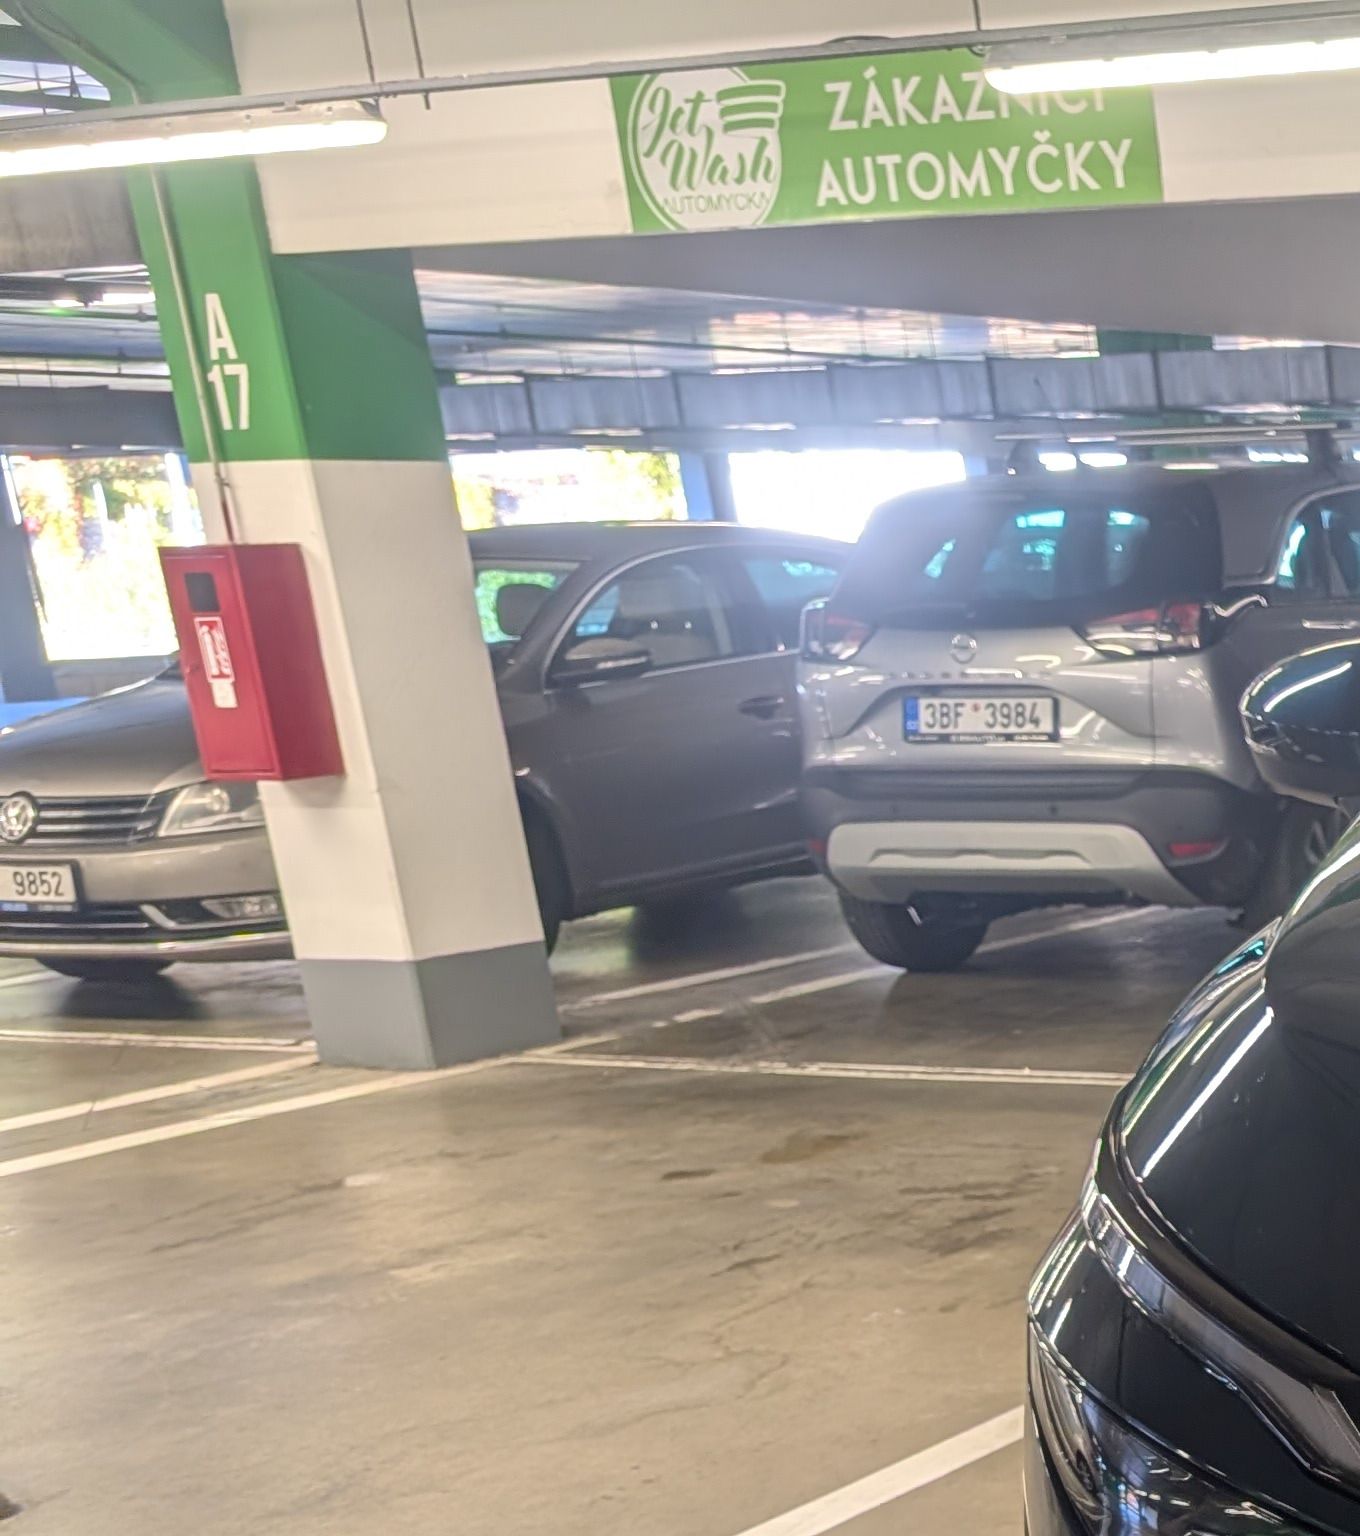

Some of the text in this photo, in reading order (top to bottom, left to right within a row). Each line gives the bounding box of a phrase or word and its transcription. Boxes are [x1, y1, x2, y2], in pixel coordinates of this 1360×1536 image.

[641, 86, 711, 158] Jet
[660, 124, 774, 193] Wash
[816, 130, 1132, 207] AUTOMYČKY
[205, 292, 238, 360] A
[207, 363, 249, 430] 17
[924, 702, 1042, 729] 3BF 3984
[13, 871, 65, 897] 9852
